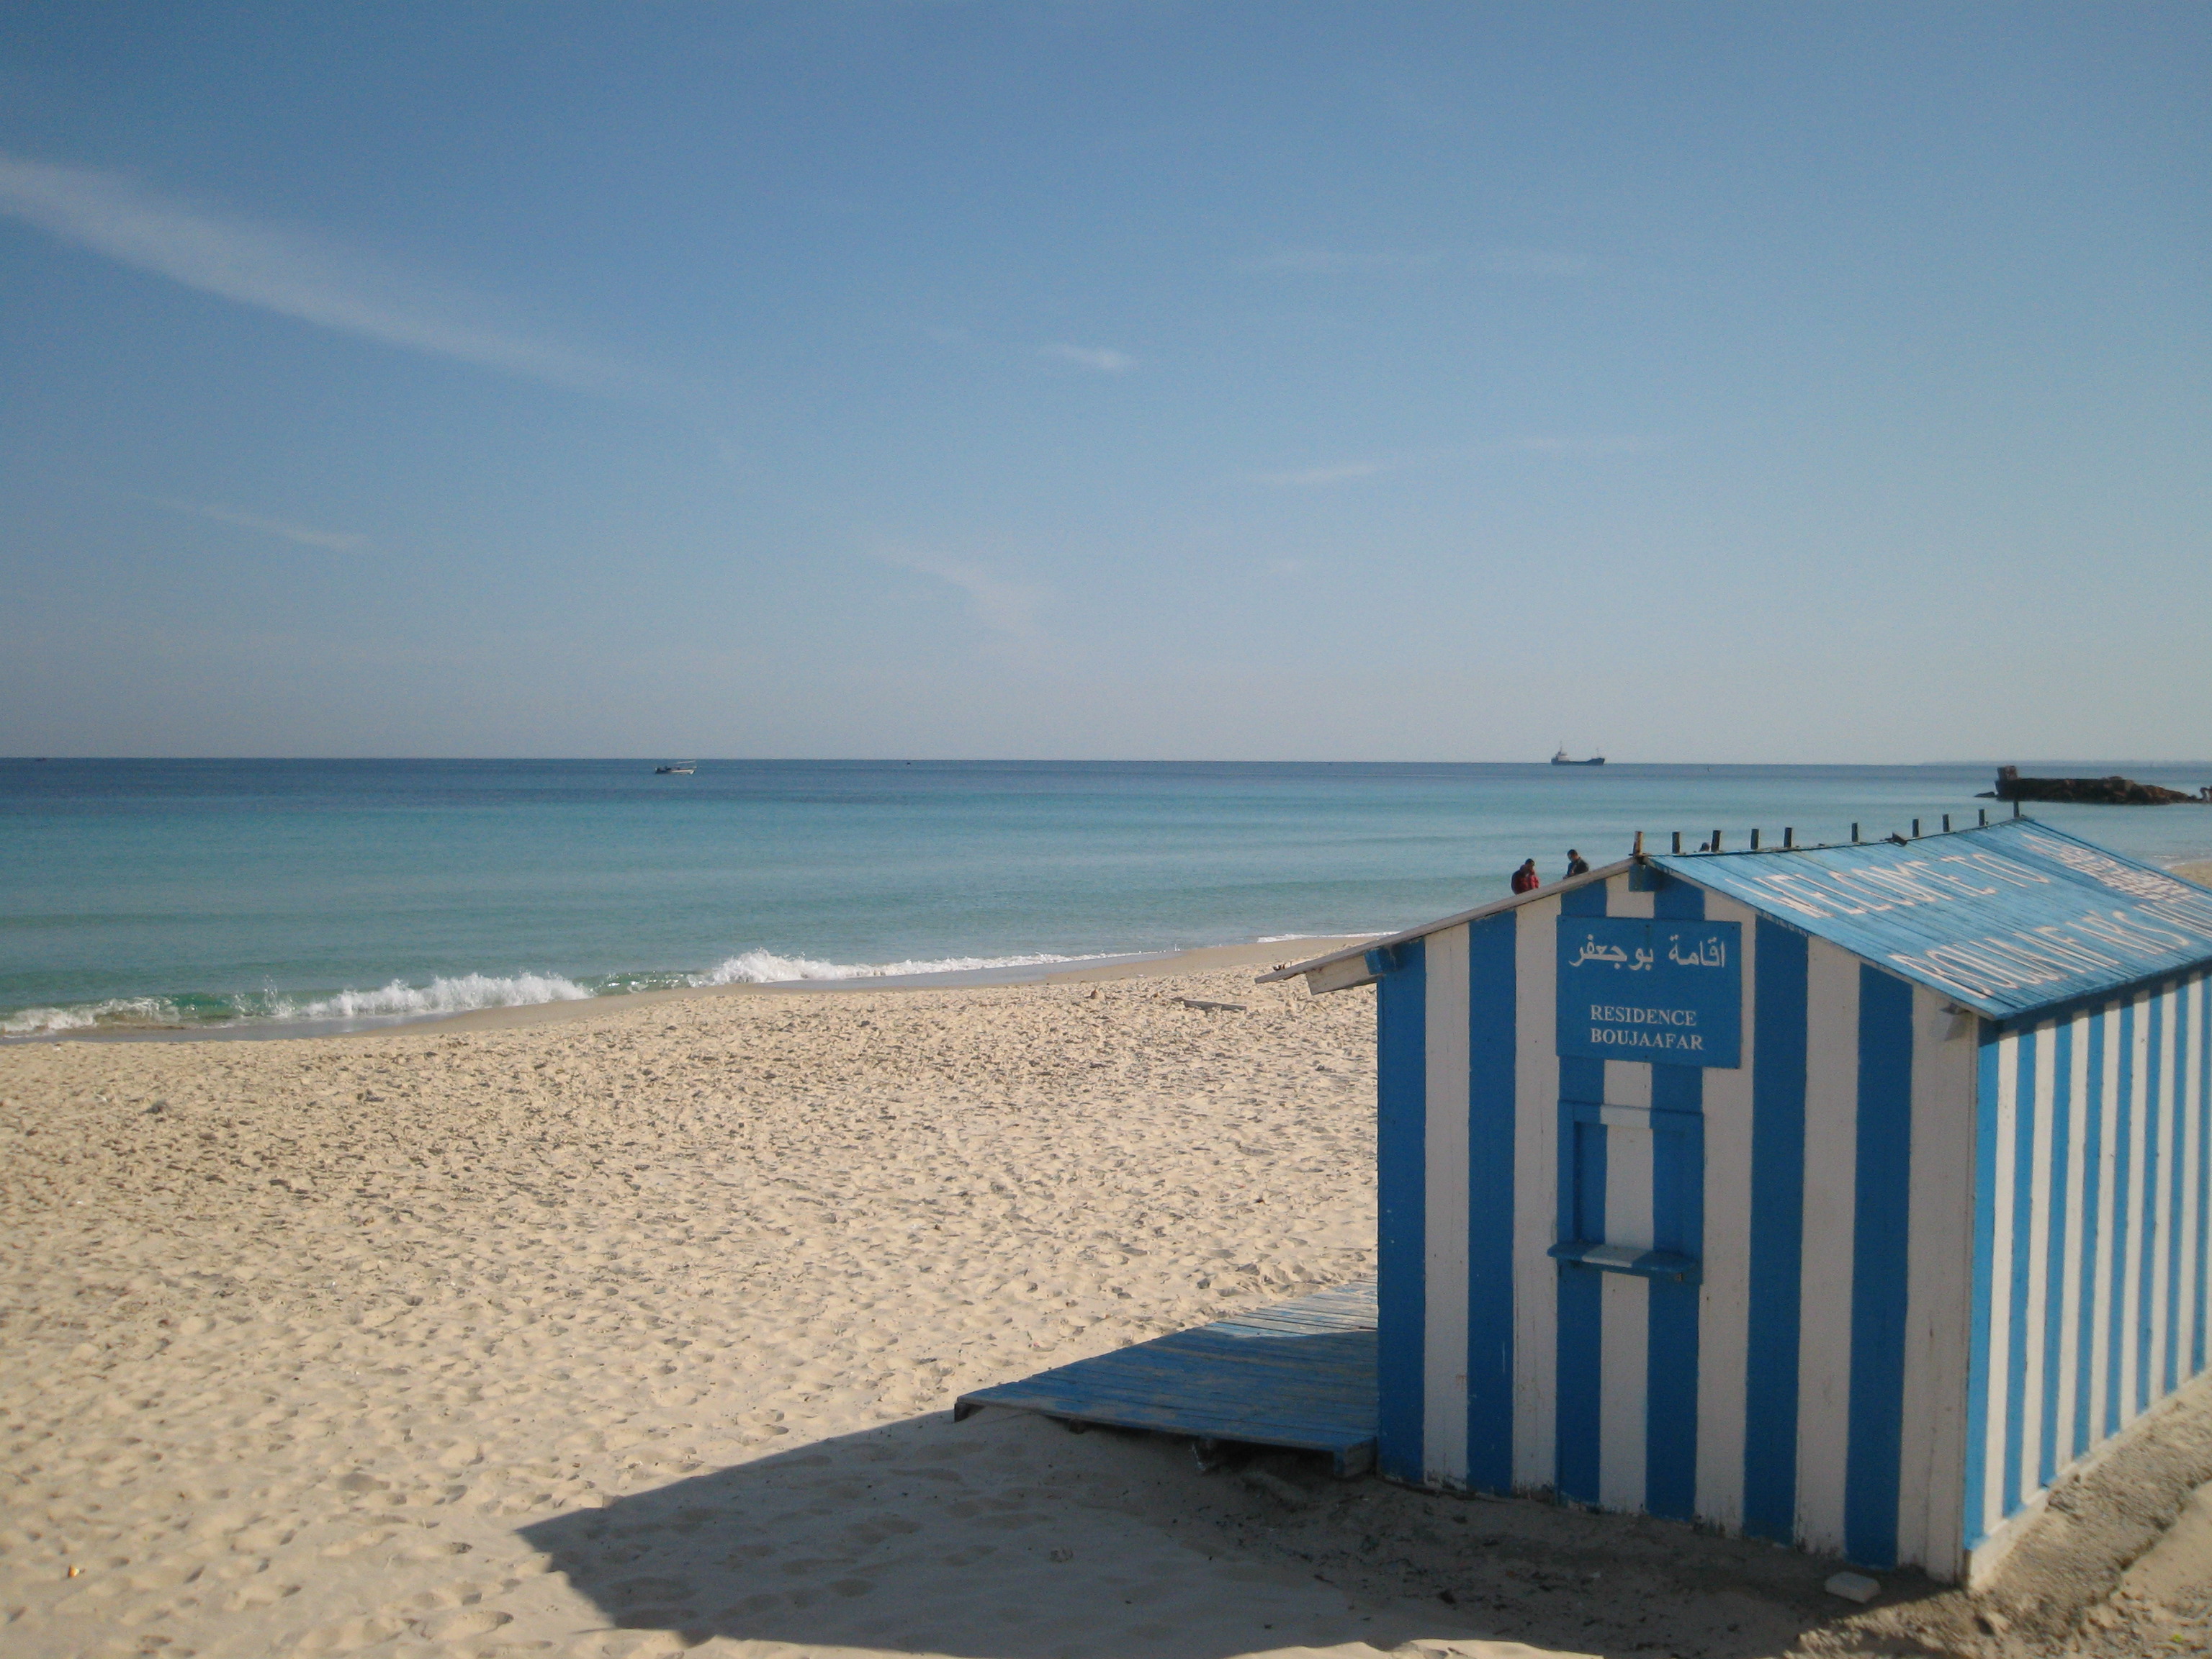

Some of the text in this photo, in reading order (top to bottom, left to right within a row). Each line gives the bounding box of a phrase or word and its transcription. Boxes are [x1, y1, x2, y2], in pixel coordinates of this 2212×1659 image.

[1725, 853, 2050, 918] WELCOME TO
[1591, 1004, 1696, 1026] RESIDENCE
[1591, 1027, 1703, 1051] BOUJAAFAR
